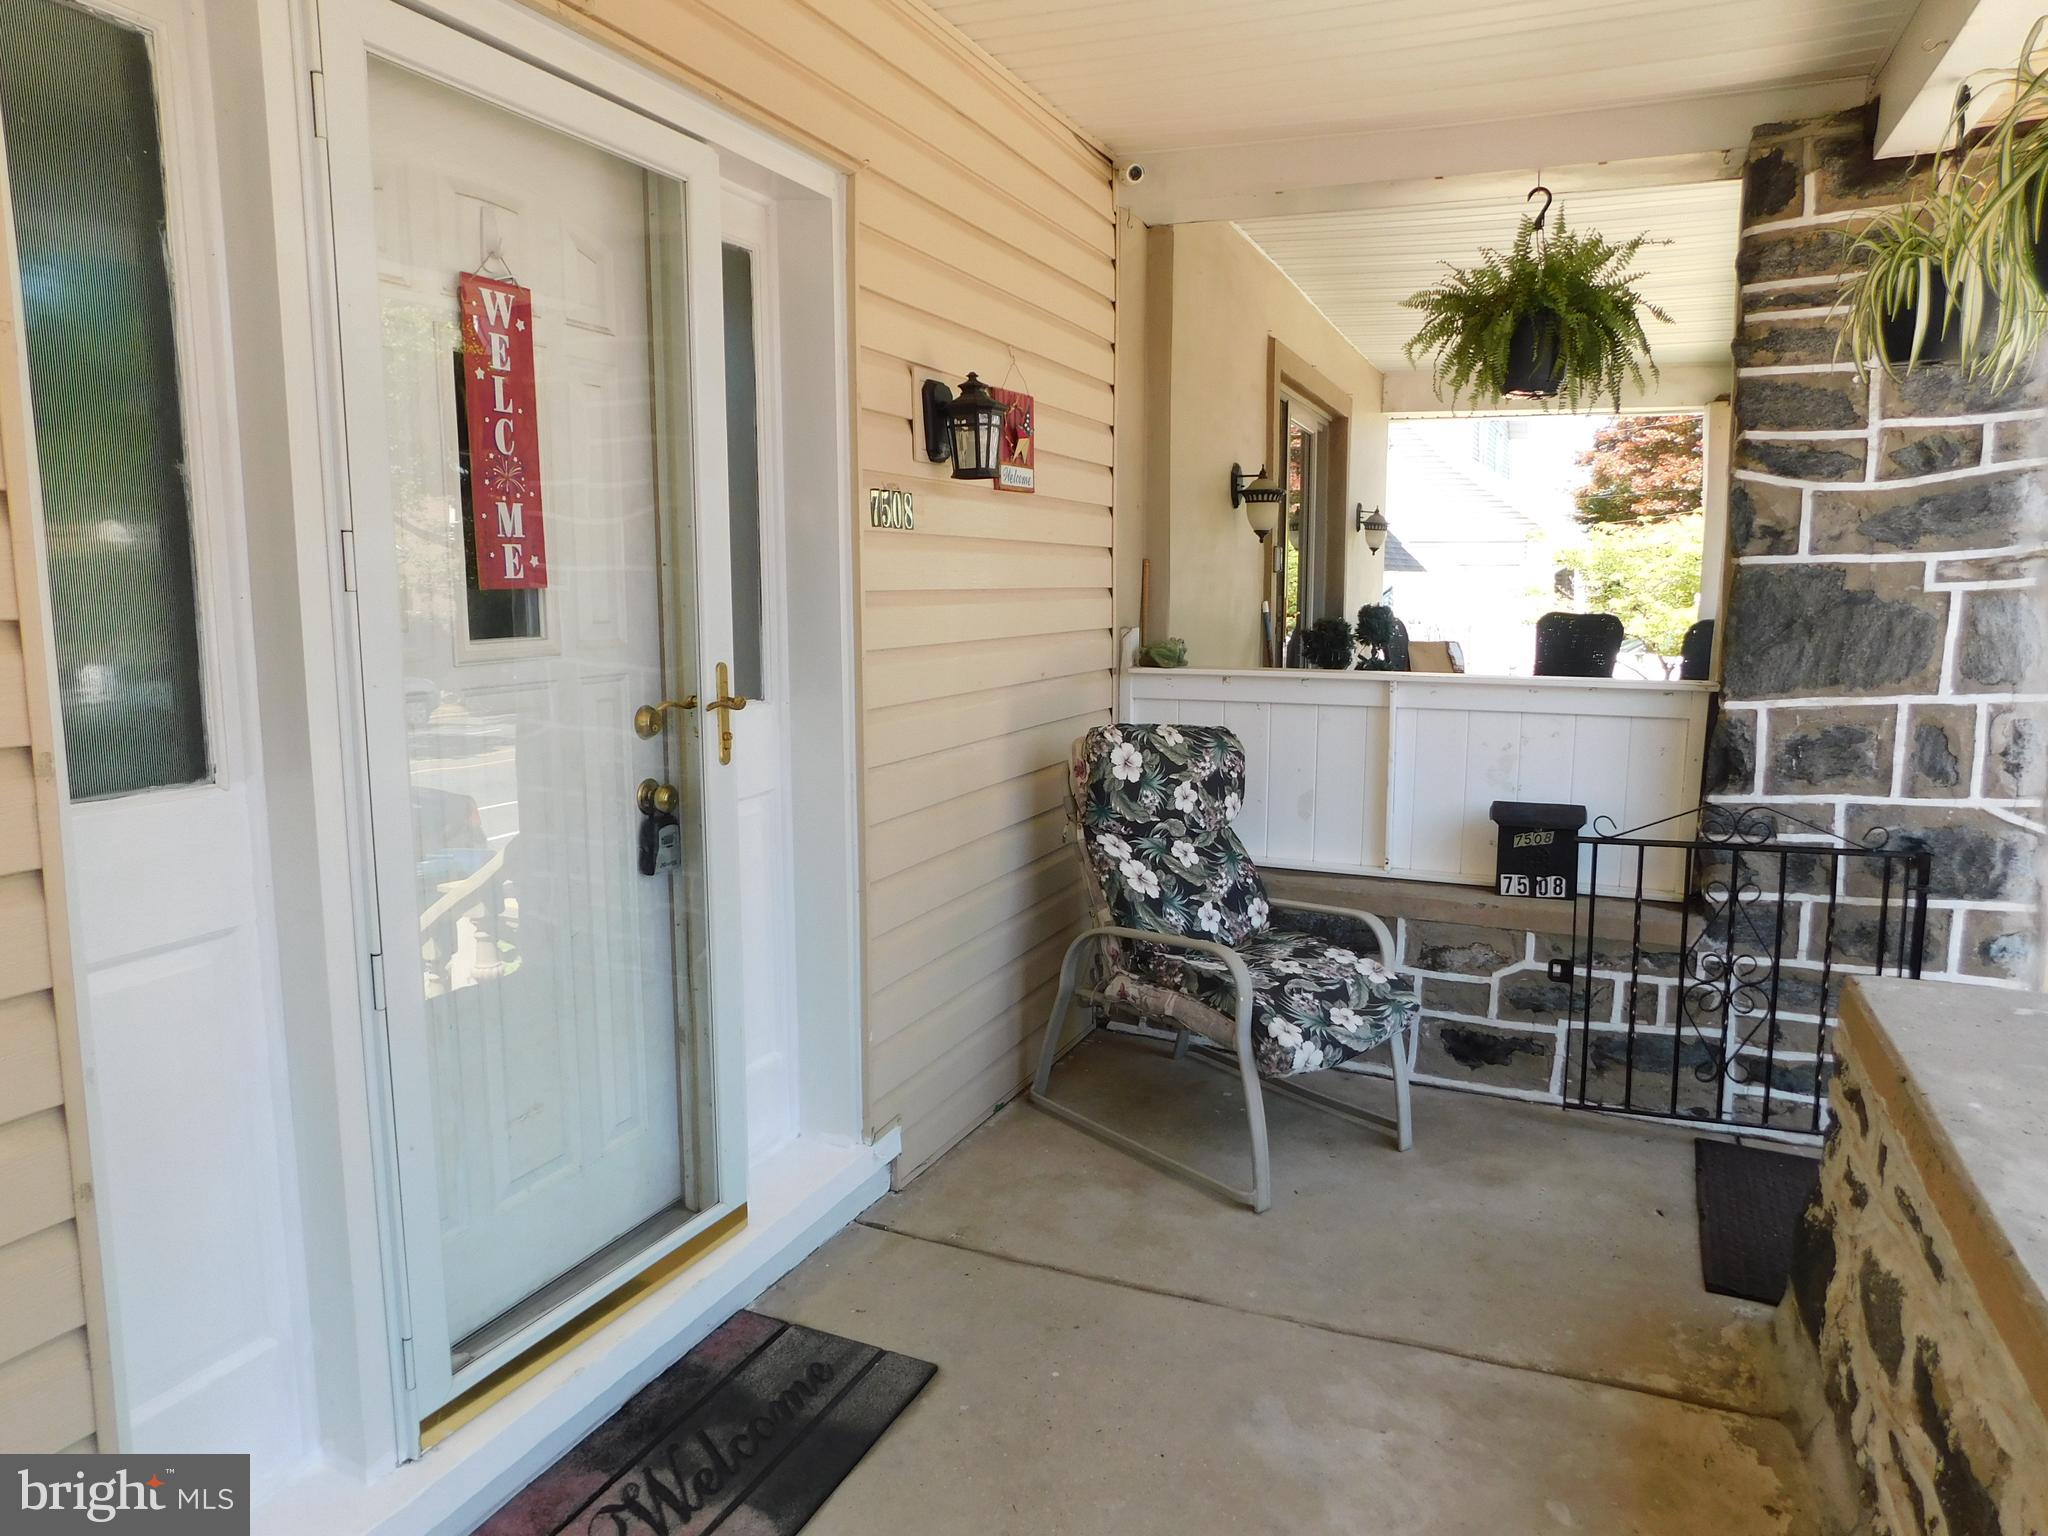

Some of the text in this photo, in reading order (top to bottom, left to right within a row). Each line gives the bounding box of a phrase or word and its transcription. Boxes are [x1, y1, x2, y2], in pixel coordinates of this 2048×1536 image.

[478, 287, 526, 579] WELCME
[1003, 467, 1031, 486] Welcome
[870, 489, 914, 529] 7508
[1515, 831, 1552, 846] 7508
[588, 1361, 834, 1536] Welcome
